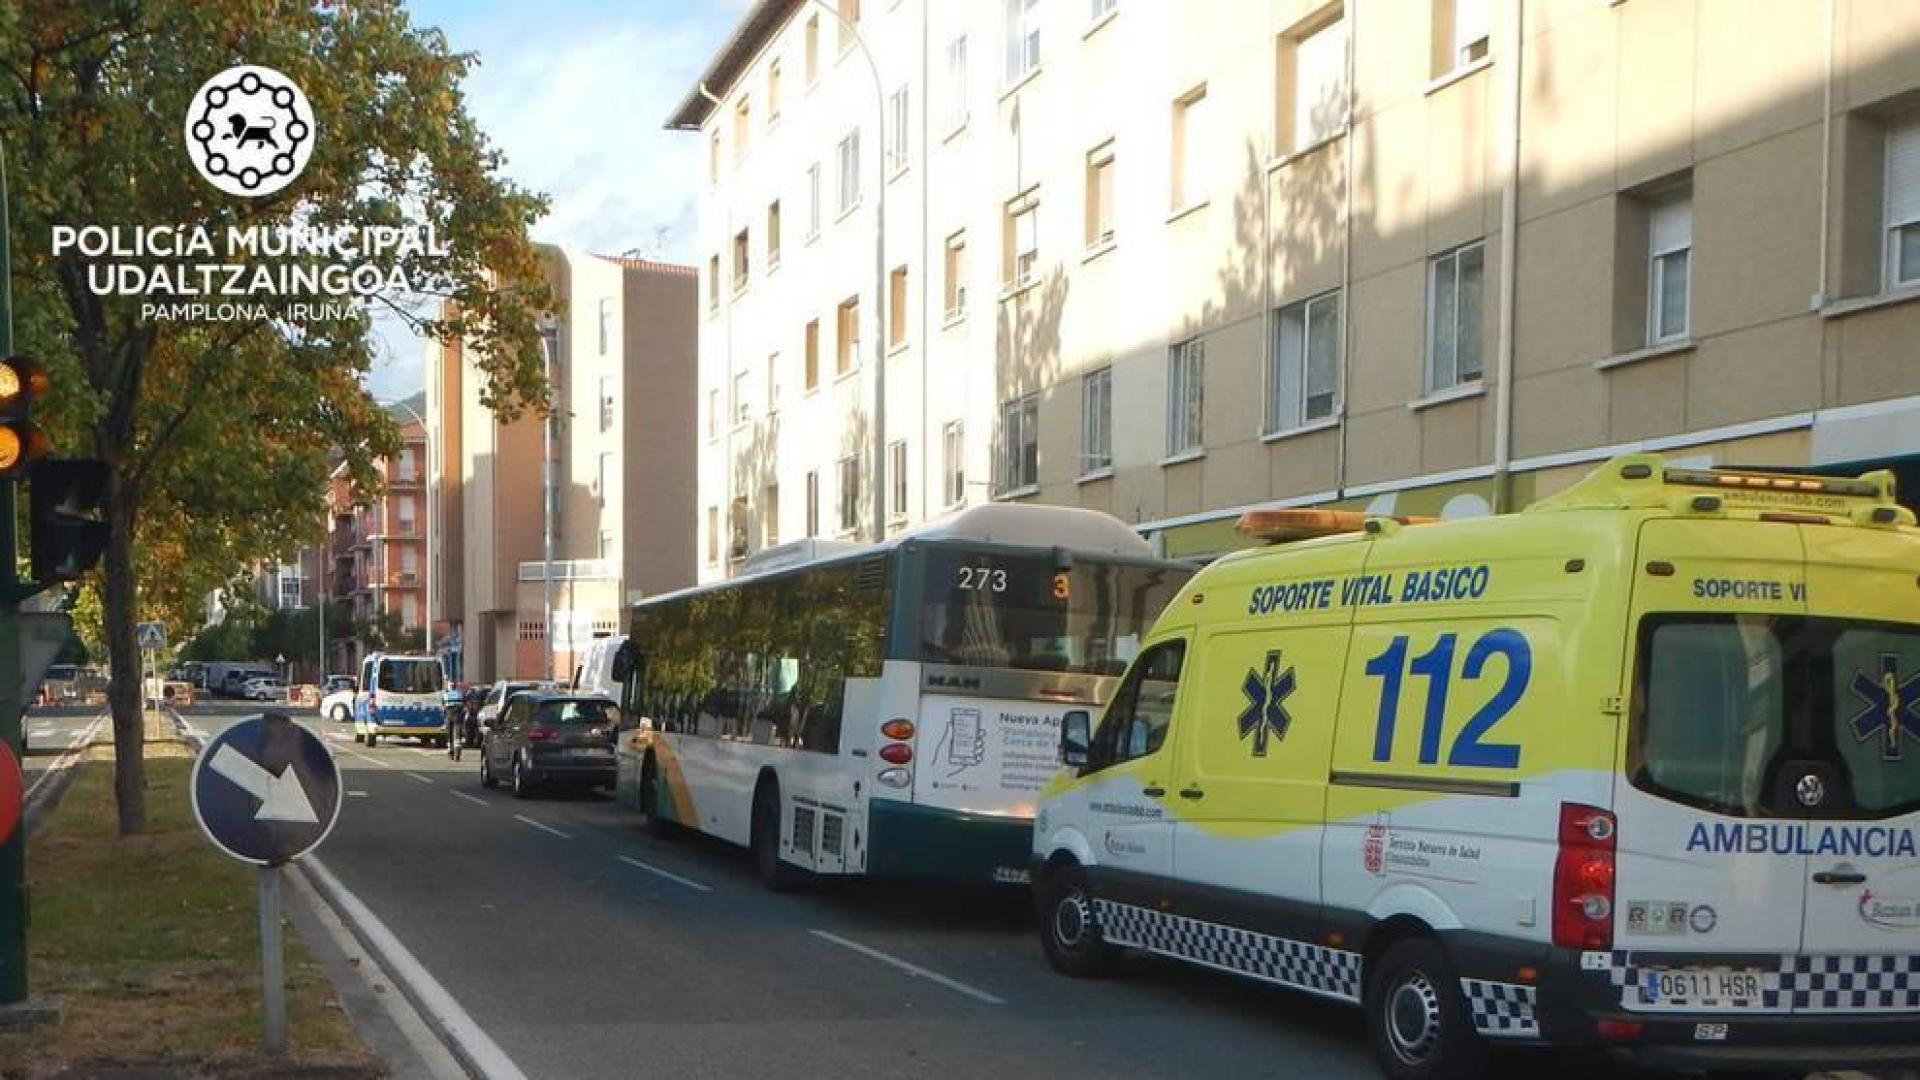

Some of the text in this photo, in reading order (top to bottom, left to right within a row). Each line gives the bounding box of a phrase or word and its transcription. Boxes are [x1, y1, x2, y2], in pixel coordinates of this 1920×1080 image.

[959, 566, 1008, 592] 273
[1249, 564, 1490, 614] SOPORTE VITAL BASICO
[1692, 578, 1782, 601] SOPORTE
[1364, 626, 1533, 769] 112
[1000, 712, 1039, 725] Nueva
[1686, 821, 1917, 858] AMBULANCIA
[1661, 974, 1758, 996] 0611 HSR
